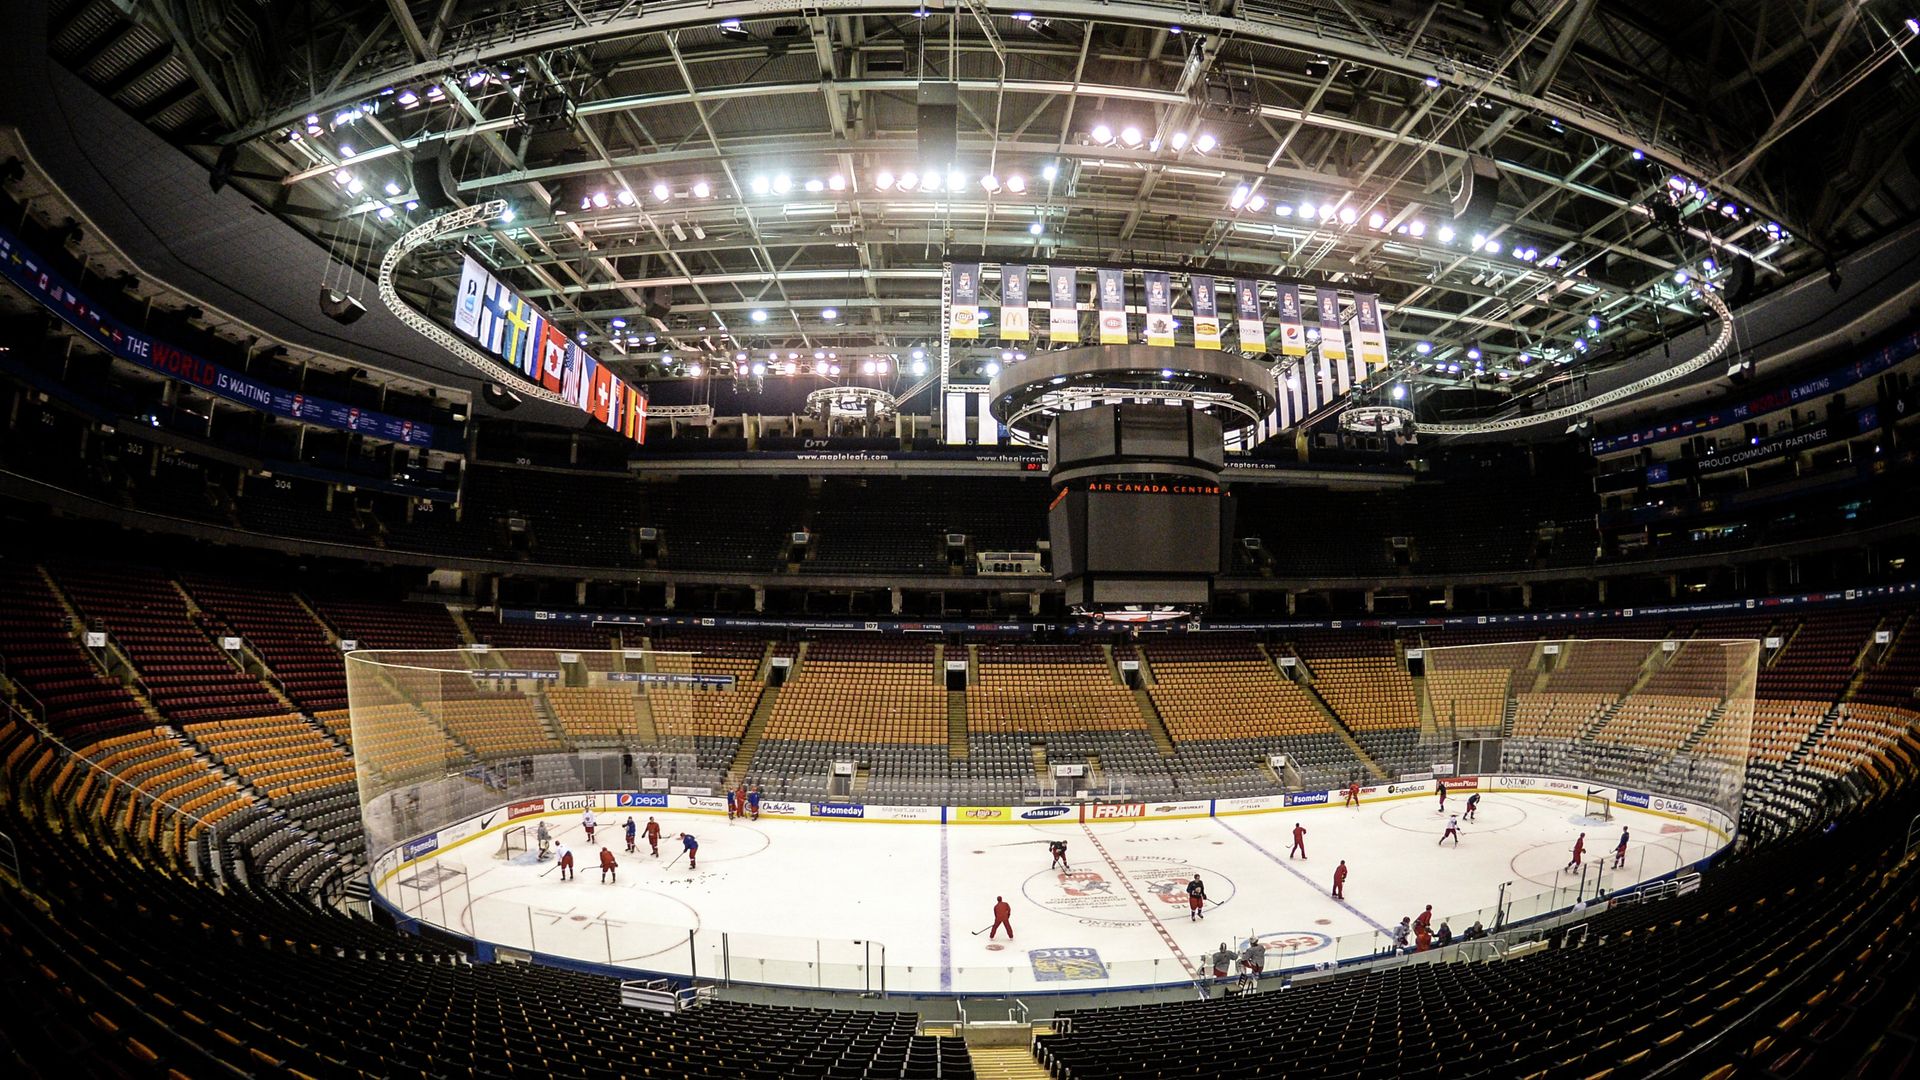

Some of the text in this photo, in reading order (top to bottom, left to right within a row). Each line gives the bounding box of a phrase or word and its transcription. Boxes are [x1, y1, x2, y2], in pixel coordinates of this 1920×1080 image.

[127, 335, 270, 404] THE WORLD IS WAITING
[1733, 378, 1830, 418] THE WORLD IS WAITING
[1698, 429, 1828, 469] PROUD COMMUNITY PARTNER
[797, 453, 889, 461] www.mapleleafs.com
[274, 479, 292, 490] 304
[1089, 483, 1220, 494] AIR CANADA CENTRE
[1500, 777, 1536, 786] ONTARIO
[1395, 785, 1425, 794] Expedia.ca
[550, 796, 596, 811] Canada
[635, 795, 666, 806] pepsi
[1293, 793, 1328, 804] #someday
[1623, 793, 1649, 807] #someday
[762, 803, 797, 811] On the Run
[821, 806, 863, 816] #someday
[1095, 804, 1141, 818] FRAM
[1035, 948, 1090, 958] RBC
